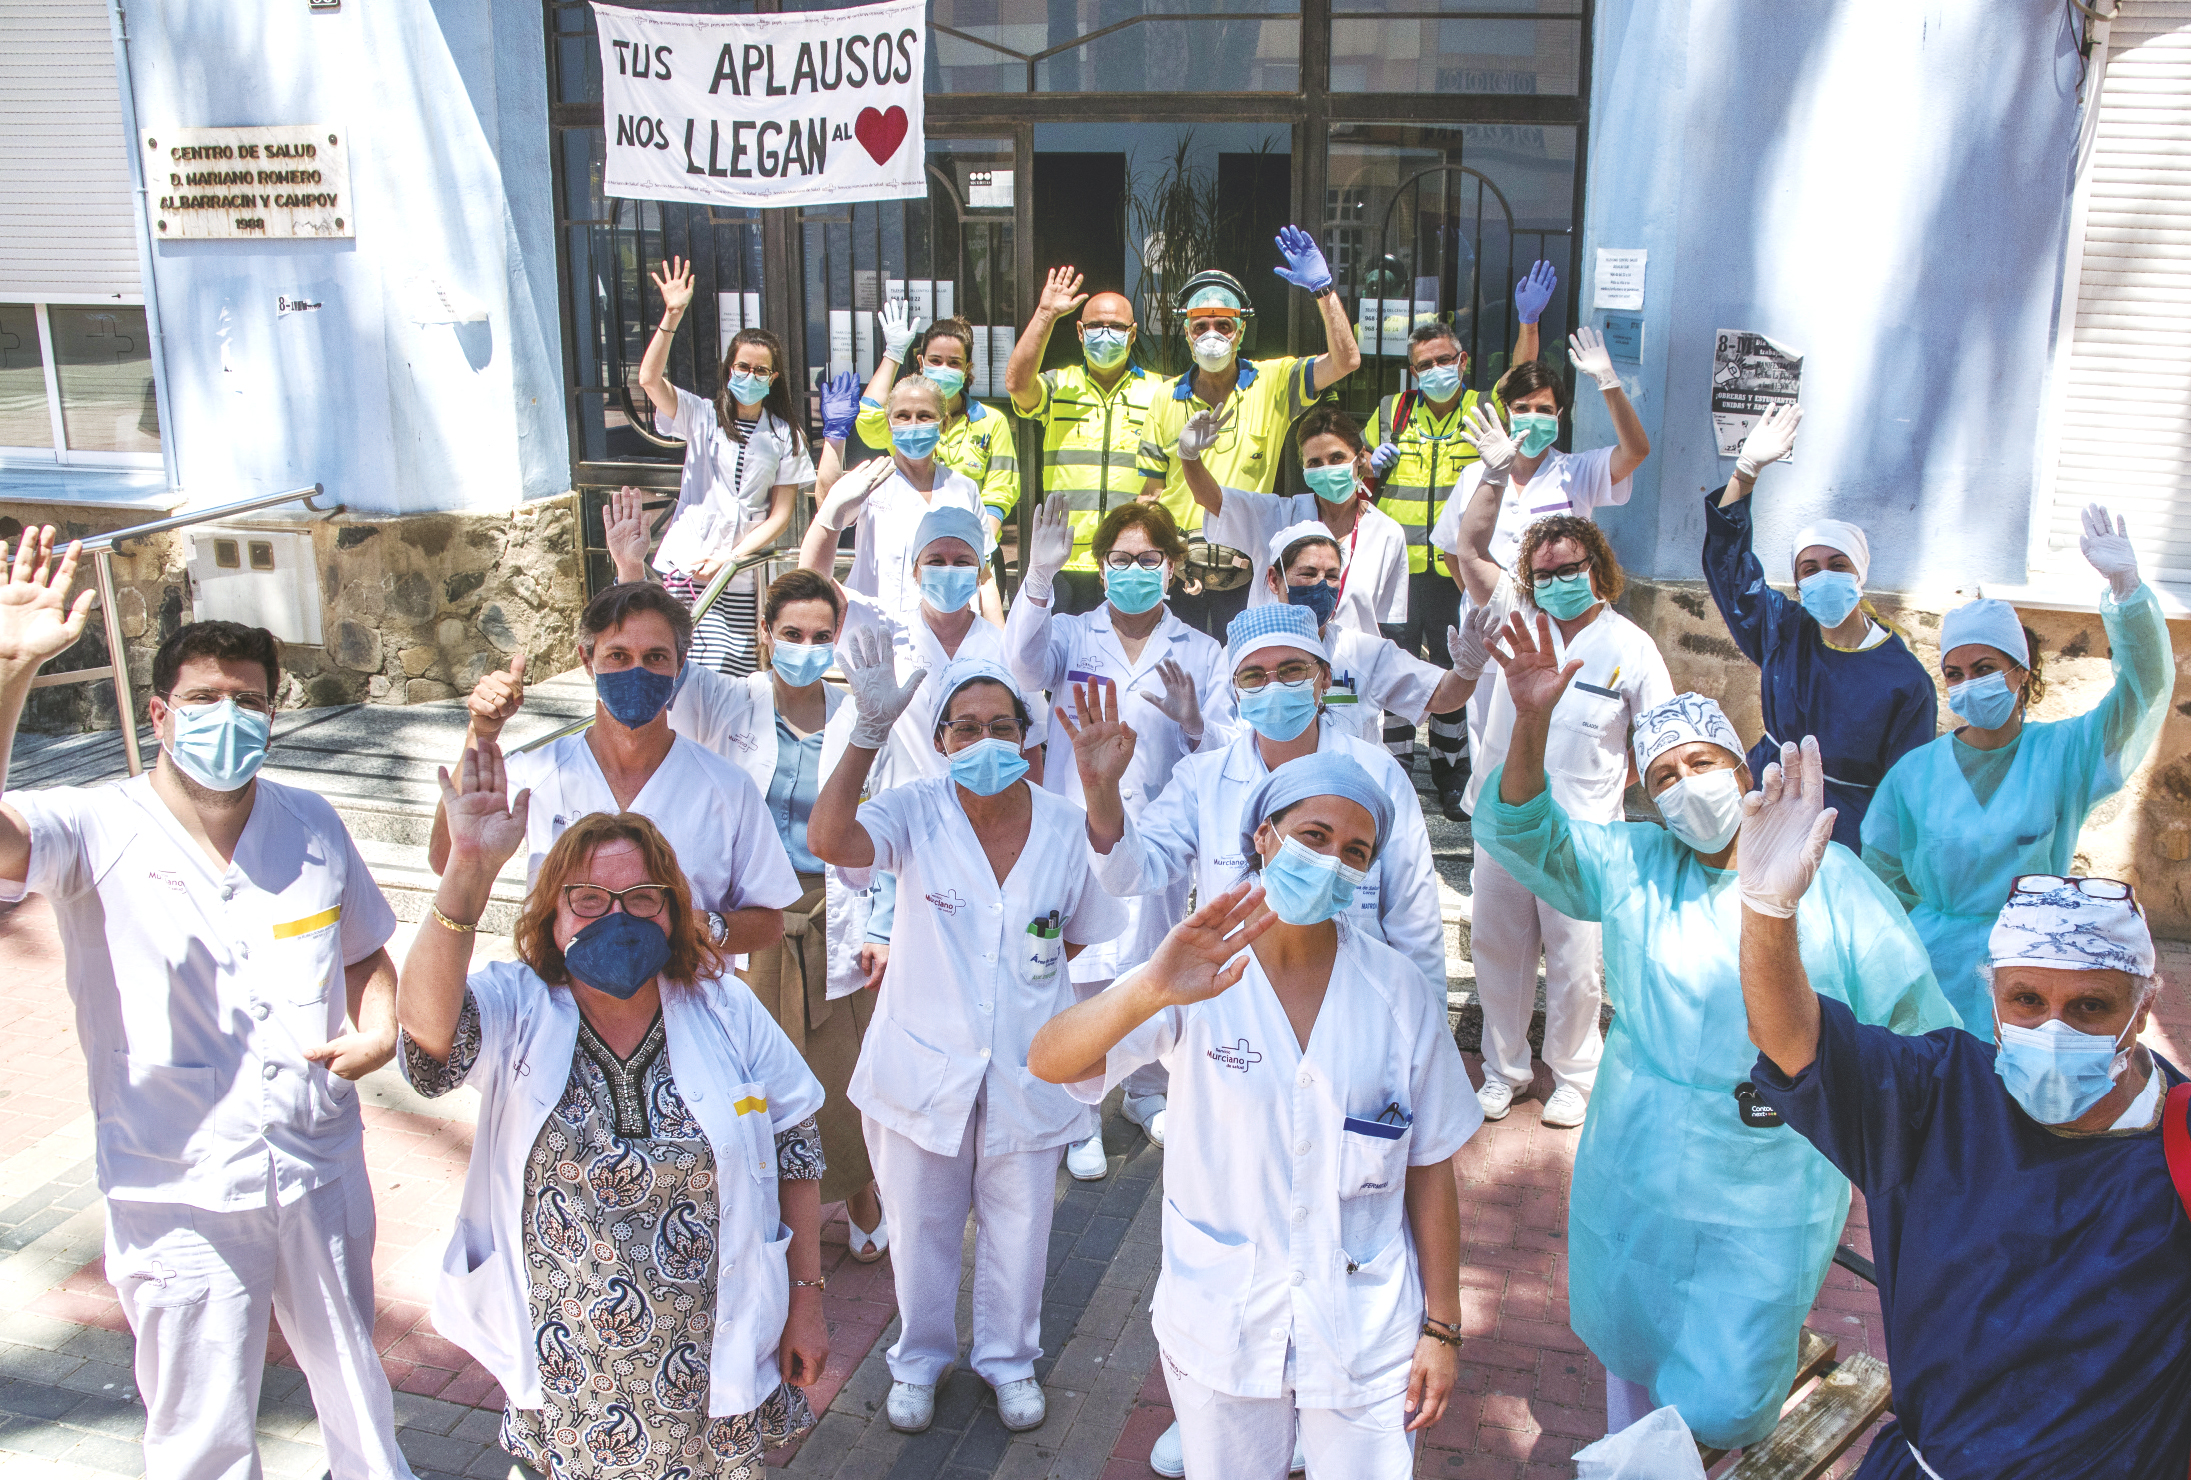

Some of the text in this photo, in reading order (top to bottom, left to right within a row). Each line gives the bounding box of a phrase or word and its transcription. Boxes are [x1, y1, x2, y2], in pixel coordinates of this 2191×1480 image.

[612, 28, 918, 96] TUS APLAUSOS
[170, 143, 316, 160] CENTRO DE SALUD
[616, 113, 853, 178] NOS LLEGAN AL
[186, 171, 254, 186] MARIANO
[257, 170, 322, 184] ROMERO
[259, 194, 270, 208] Y
[274, 193, 337, 208] CAMPOY
[1722, 401, 1745, 409] UNIDAS
[1213, 858, 1245, 866] Murciano
[1206, 1049, 1245, 1065] Murciano
